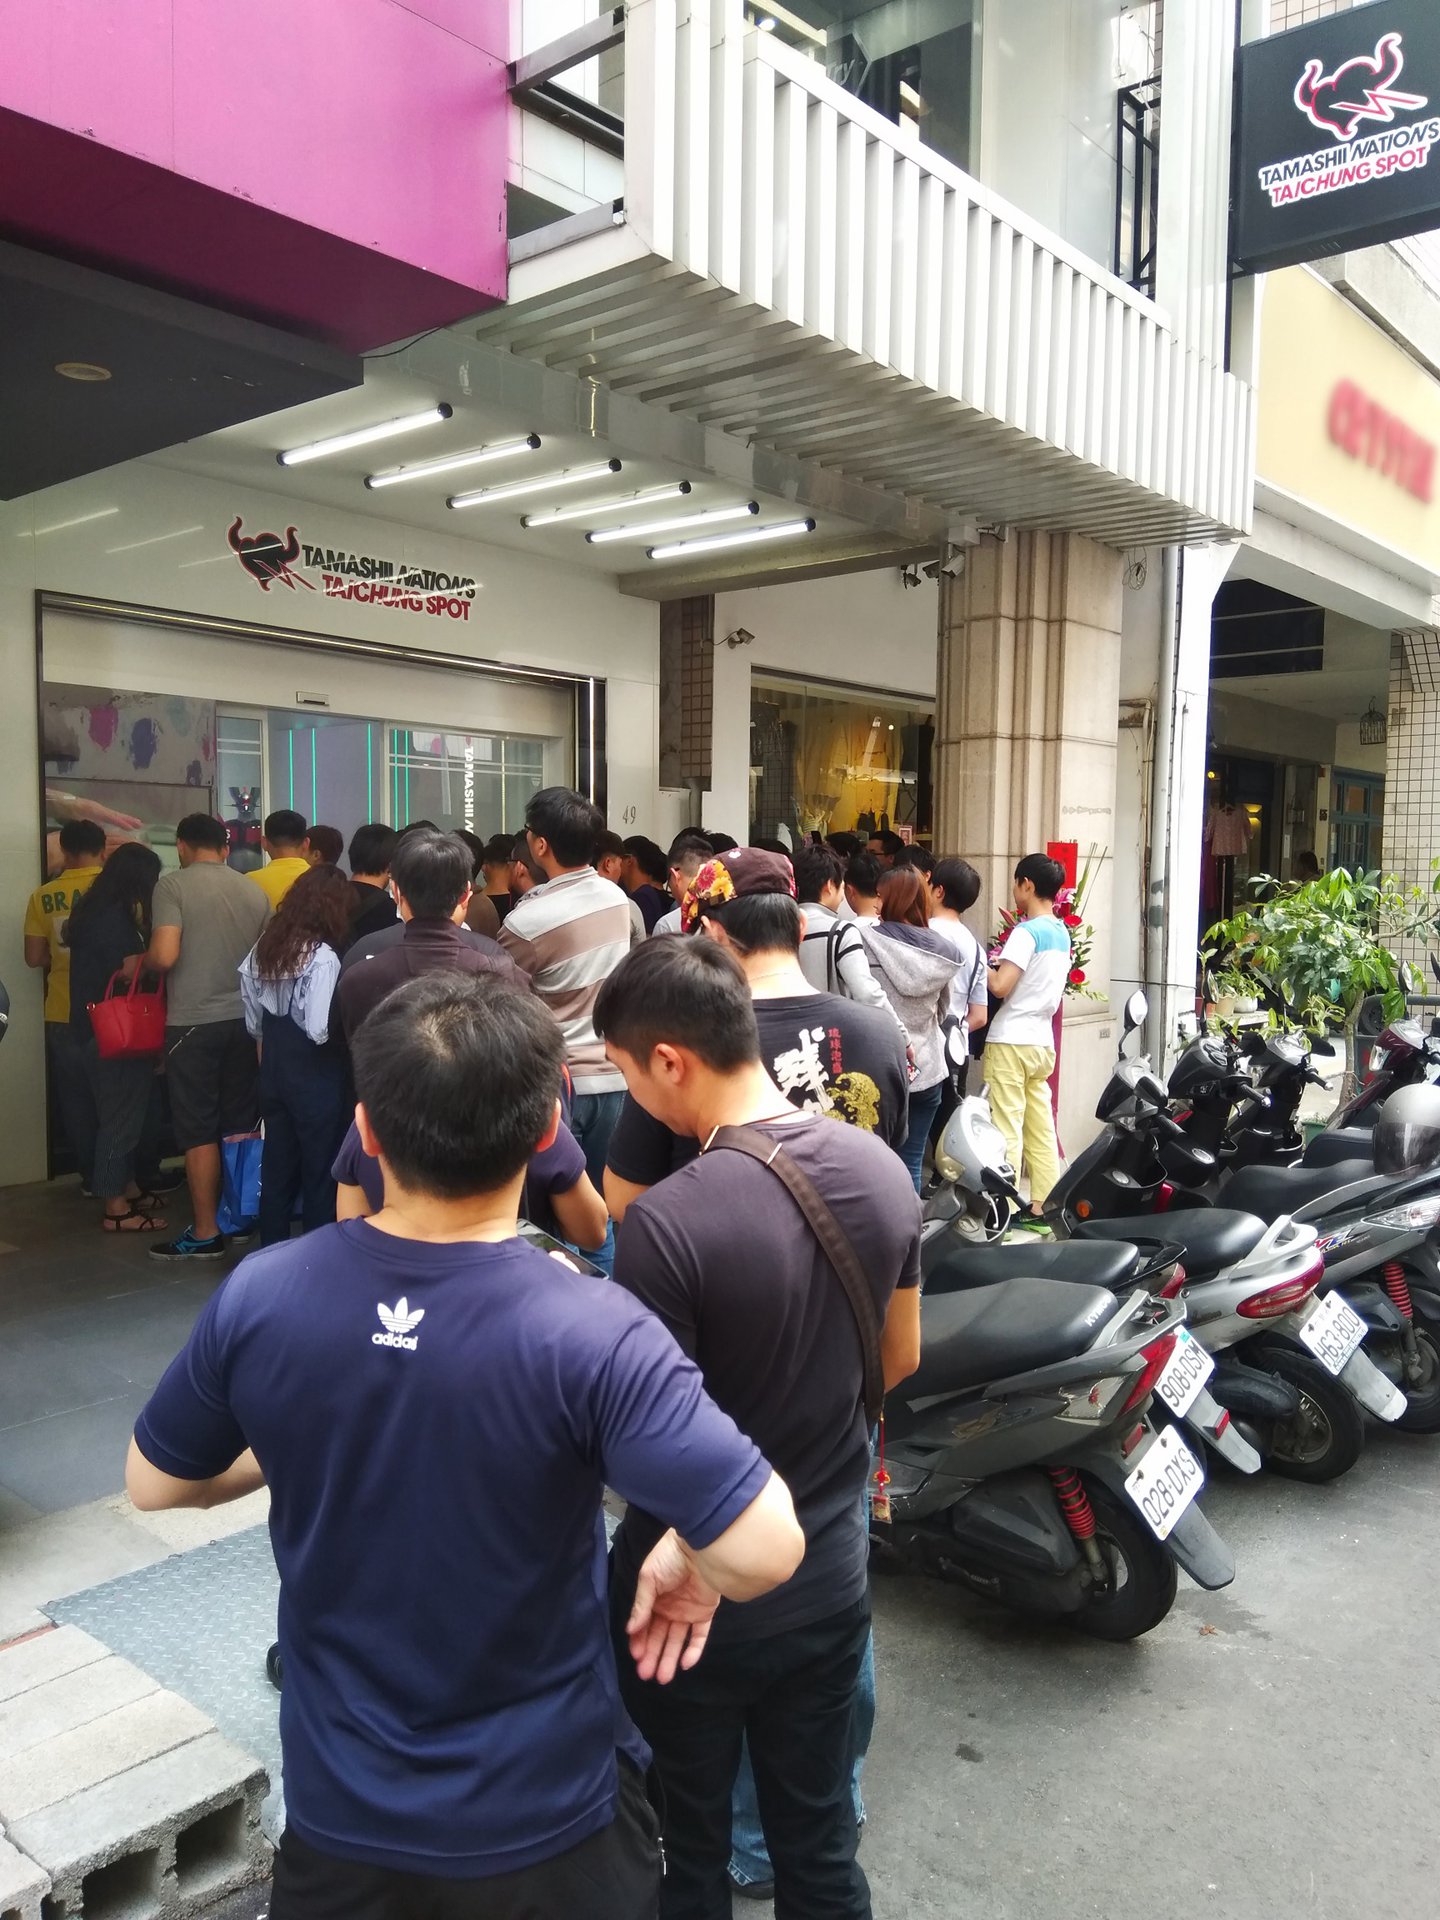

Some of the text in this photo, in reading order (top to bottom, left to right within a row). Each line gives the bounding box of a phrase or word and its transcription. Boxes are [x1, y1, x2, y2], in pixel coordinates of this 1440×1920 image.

[1262, 121, 1439, 186] TAMASHII NATIONS
[1273, 147, 1426, 203] TAICHUNG SPOT
[302, 544, 476, 599] TAMASHII NATIONS
[322, 574, 471, 620] TAICHUNG SPOT
[464, 746, 474, 817] TAMASHII
[623, 805, 636, 824] 49
[42, 889, 81, 914] BRA
[372, 1332, 418, 1351] adidas
